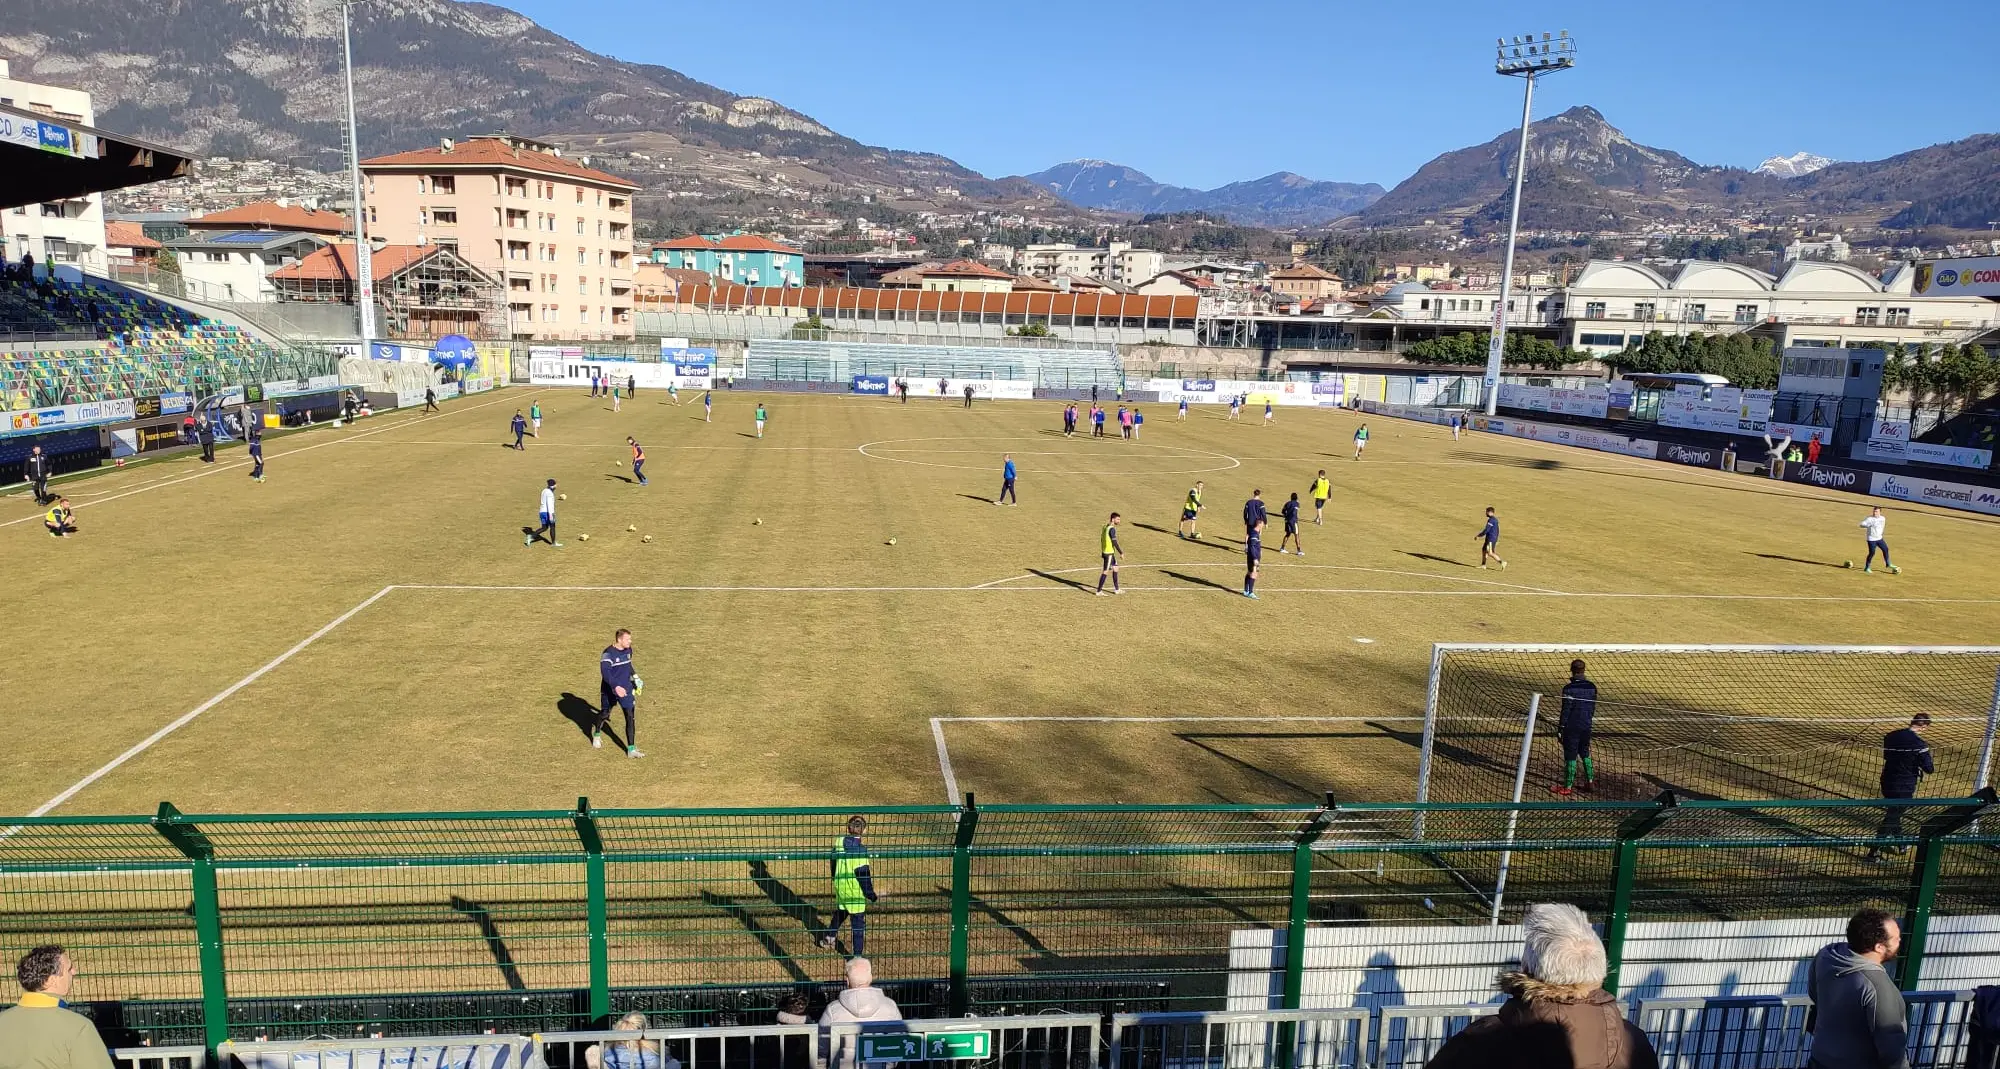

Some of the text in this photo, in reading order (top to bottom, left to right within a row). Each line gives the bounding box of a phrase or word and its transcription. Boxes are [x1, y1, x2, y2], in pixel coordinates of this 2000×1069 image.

[1677, 446, 1710, 464] TRENTINO
[1811, 466, 1856, 487] TRENTINO
[1881, 481, 1909, 495] Activa
